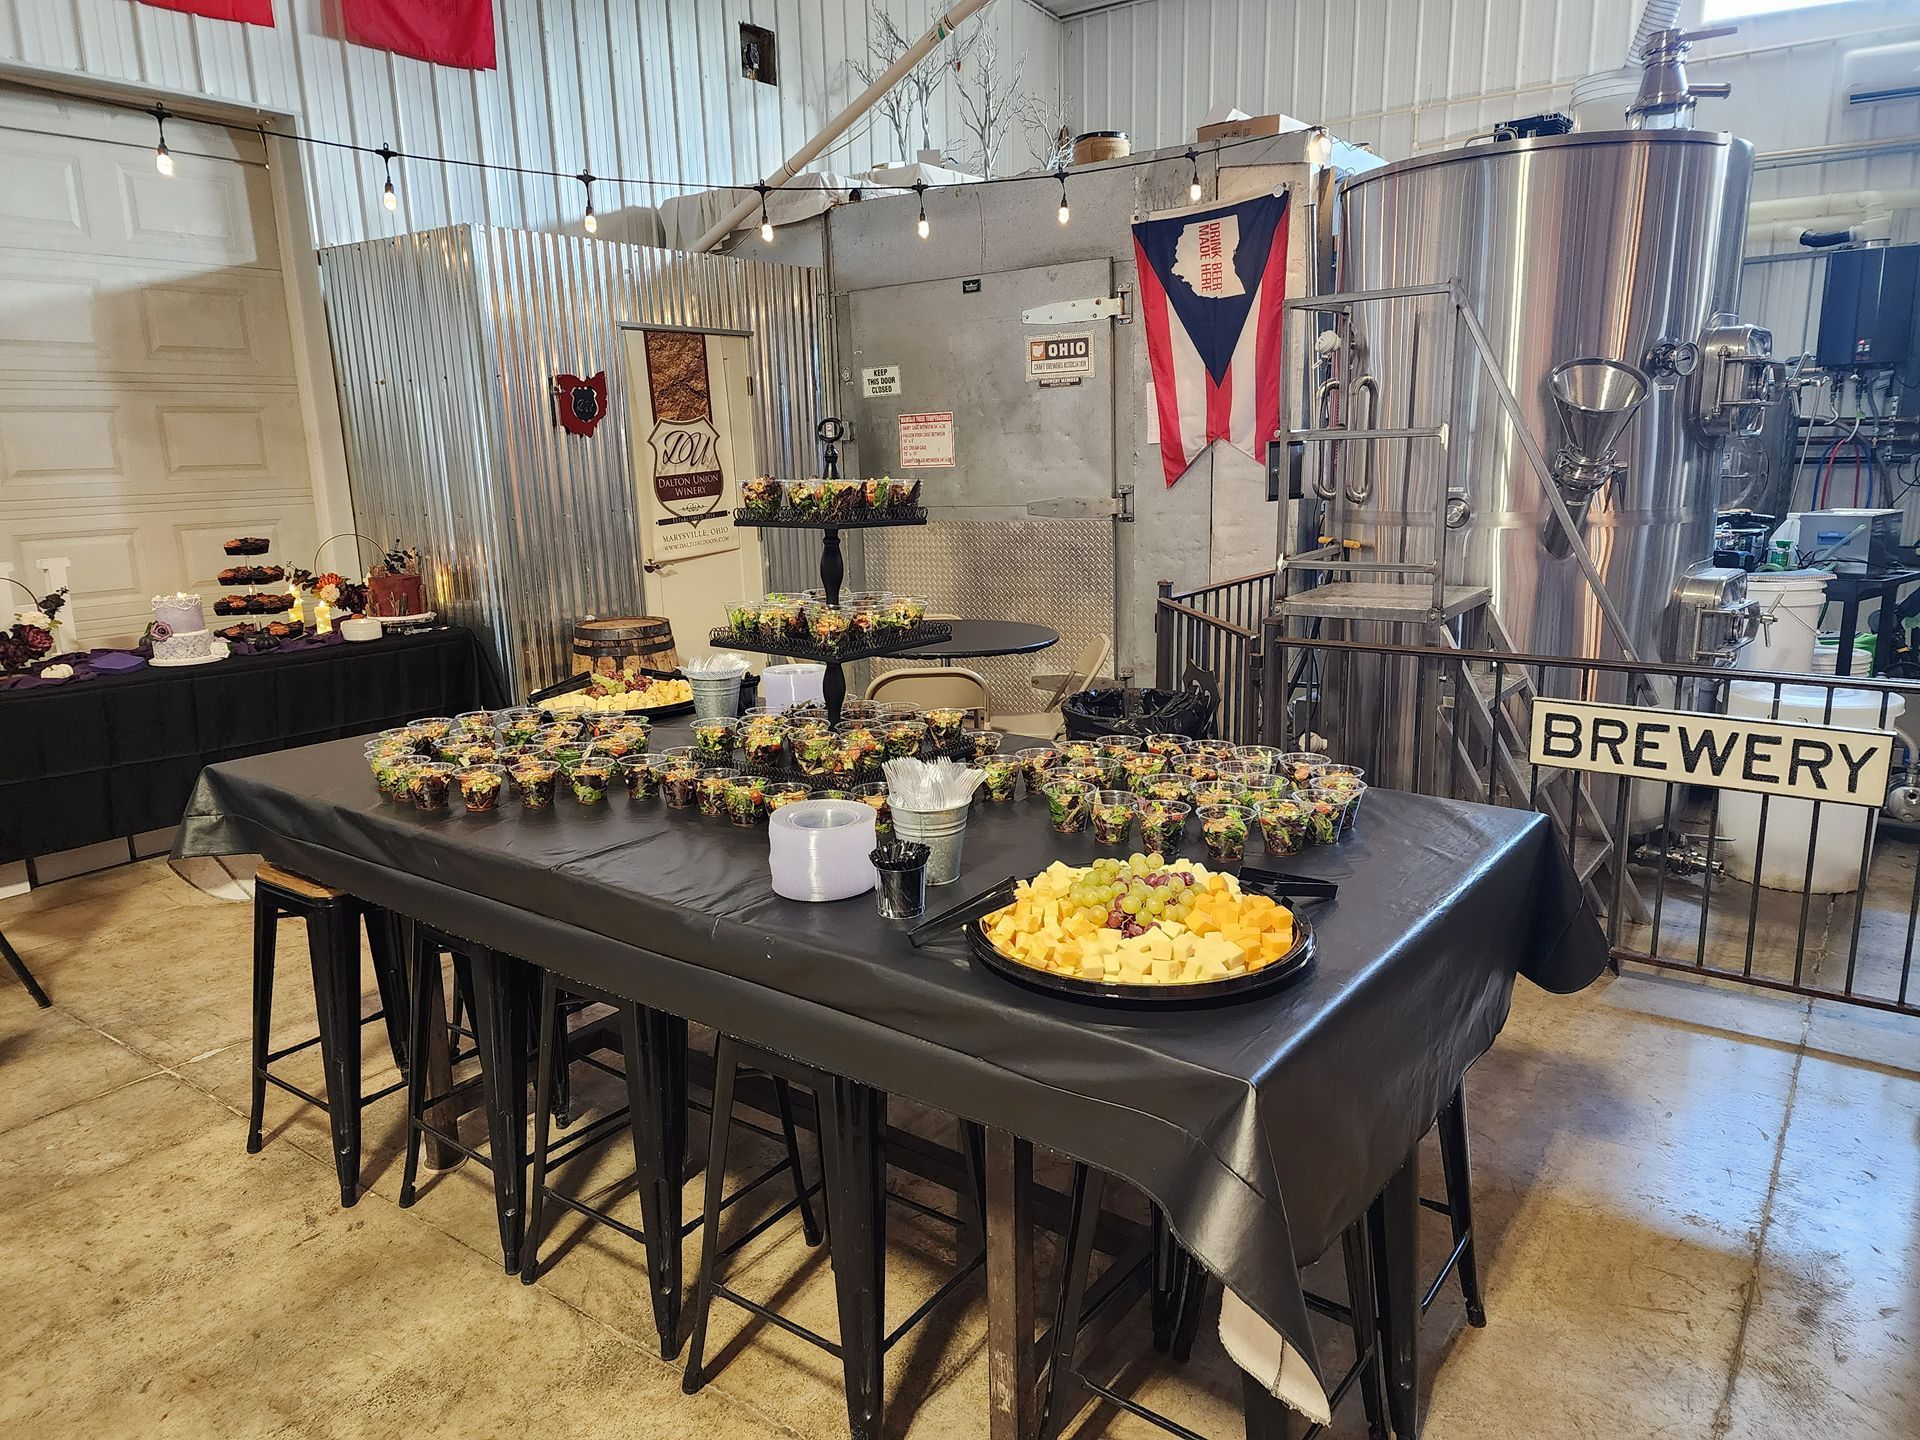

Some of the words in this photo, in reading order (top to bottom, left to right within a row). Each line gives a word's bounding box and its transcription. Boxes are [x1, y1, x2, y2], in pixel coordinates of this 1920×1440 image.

[1198, 224, 1210, 260] MADE
[1209, 222, 1222, 259] DRINK
[1201, 263, 1212, 292] HERE
[1212, 262, 1223, 291] BEER
[1048, 341, 1086, 357] OHIO
[874, 369, 888, 377] KEEP
[1034, 362, 1046, 371] CRAFT
[1046, 362, 1063, 370] BREWERS
[1064, 360, 1086, 368] ASSOCIATION
[867, 378, 880, 386] THIS
[881, 376, 896, 385] DOOR
[872, 386, 893, 394] CLOSED
[658, 476, 691, 489] DALTON
[692, 473, 719, 485] UNION
[674, 485, 707, 497] WINERY
[662, 529, 709, 543] MARYSVILLE,
[710, 526, 729, 536] OHIO
[1543, 712, 1878, 794] BREWERY
